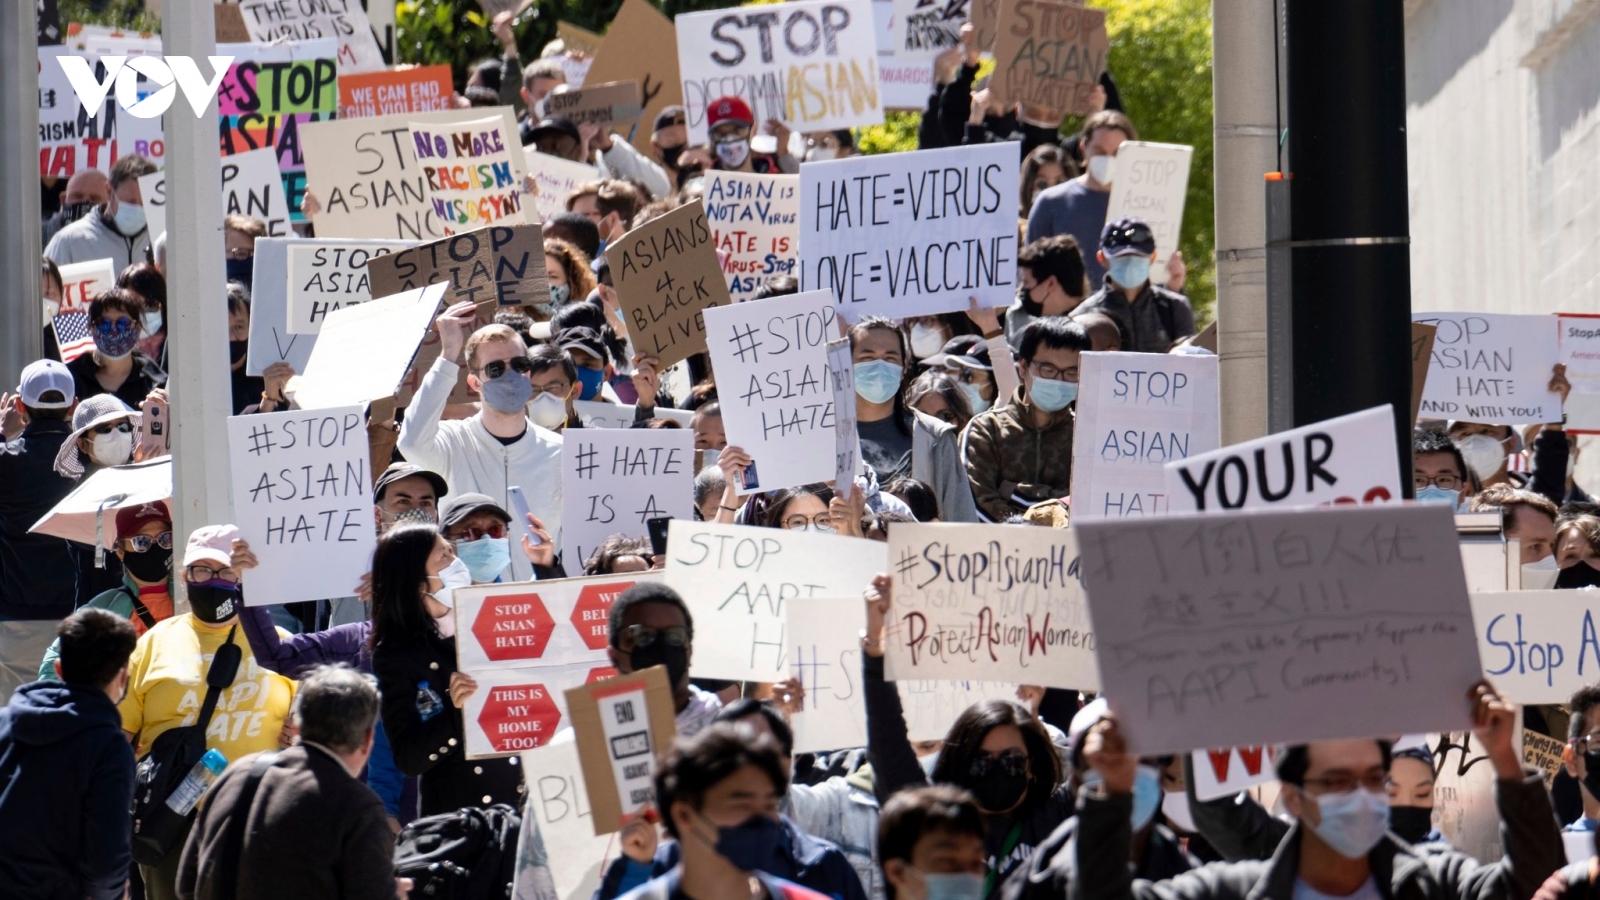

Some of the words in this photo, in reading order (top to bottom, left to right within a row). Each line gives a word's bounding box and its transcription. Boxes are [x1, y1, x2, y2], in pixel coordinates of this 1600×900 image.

[245, 0, 294, 24] THE
[332, 15, 354, 36] IS
[1010, 0, 1105, 46] STOP
[711, 5, 850, 66] STOP
[879, 66, 930, 84] WARDS
[1008, 37, 1103, 85] ASIAN
[351, 86, 374, 104] WE
[377, 82, 407, 101] CAN
[411, 80, 439, 98] END
[39, 119, 75, 142] RISM
[413, 130, 447, 158] NO
[450, 128, 504, 158] MORE
[423, 160, 514, 193] RACISM
[1129, 159, 1178, 187] STOP
[708, 177, 775, 200] ASIAN
[780, 187, 794, 199] IS
[431, 189, 521, 224] MISOGYNY
[706, 202, 739, 223] NOT
[740, 205, 753, 221] A
[755, 201, 797, 225] VIRUS
[394, 225, 514, 279] STOP
[621, 213, 709, 282] ASIANS
[772, 237, 790, 254] IS
[656, 271, 675, 294] 4
[631, 275, 710, 332] BLACK
[654, 304, 718, 354] LIVE
[728, 305, 836, 363] #STOP
[1112, 369, 1188, 399] STOP
[1455, 376, 1514, 397] HATE
[761, 401, 836, 441] HATE
[1421, 400, 1459, 414] AND
[1465, 404, 1504, 418] WITH
[1507, 406, 1543, 419] YOU!
[247, 413, 360, 457] #STOP
[1101, 429, 1189, 459] ASIAN
[575, 443, 600, 480] #
[611, 446, 682, 477] HATE
[1178, 431, 1338, 511] YOUR
[249, 457, 363, 503] ASIAN
[585, 494, 615, 524] IS
[635, 494, 667, 525] A
[1103, 491, 1170, 517] HAT
[266, 508, 362, 545] HATE
[675, 532, 782, 573] STOP
[494, 604, 532, 616] STOP
[493, 619, 536, 632] ASIAN
[496, 635, 535, 648] HATE
[1485, 613, 1564, 687] Stop
[493, 690, 526, 702] THIS
[529, 689, 543, 700] IS
[1146, 660, 1271, 720] AAPI
[1280, 652, 1414, 695] Community!
[507, 705, 530, 717] MY
[613, 700, 635, 724] END
[181, 711, 268, 742] ATE
[498, 721, 542, 734] HOME
[502, 737, 539, 750] TOO!
